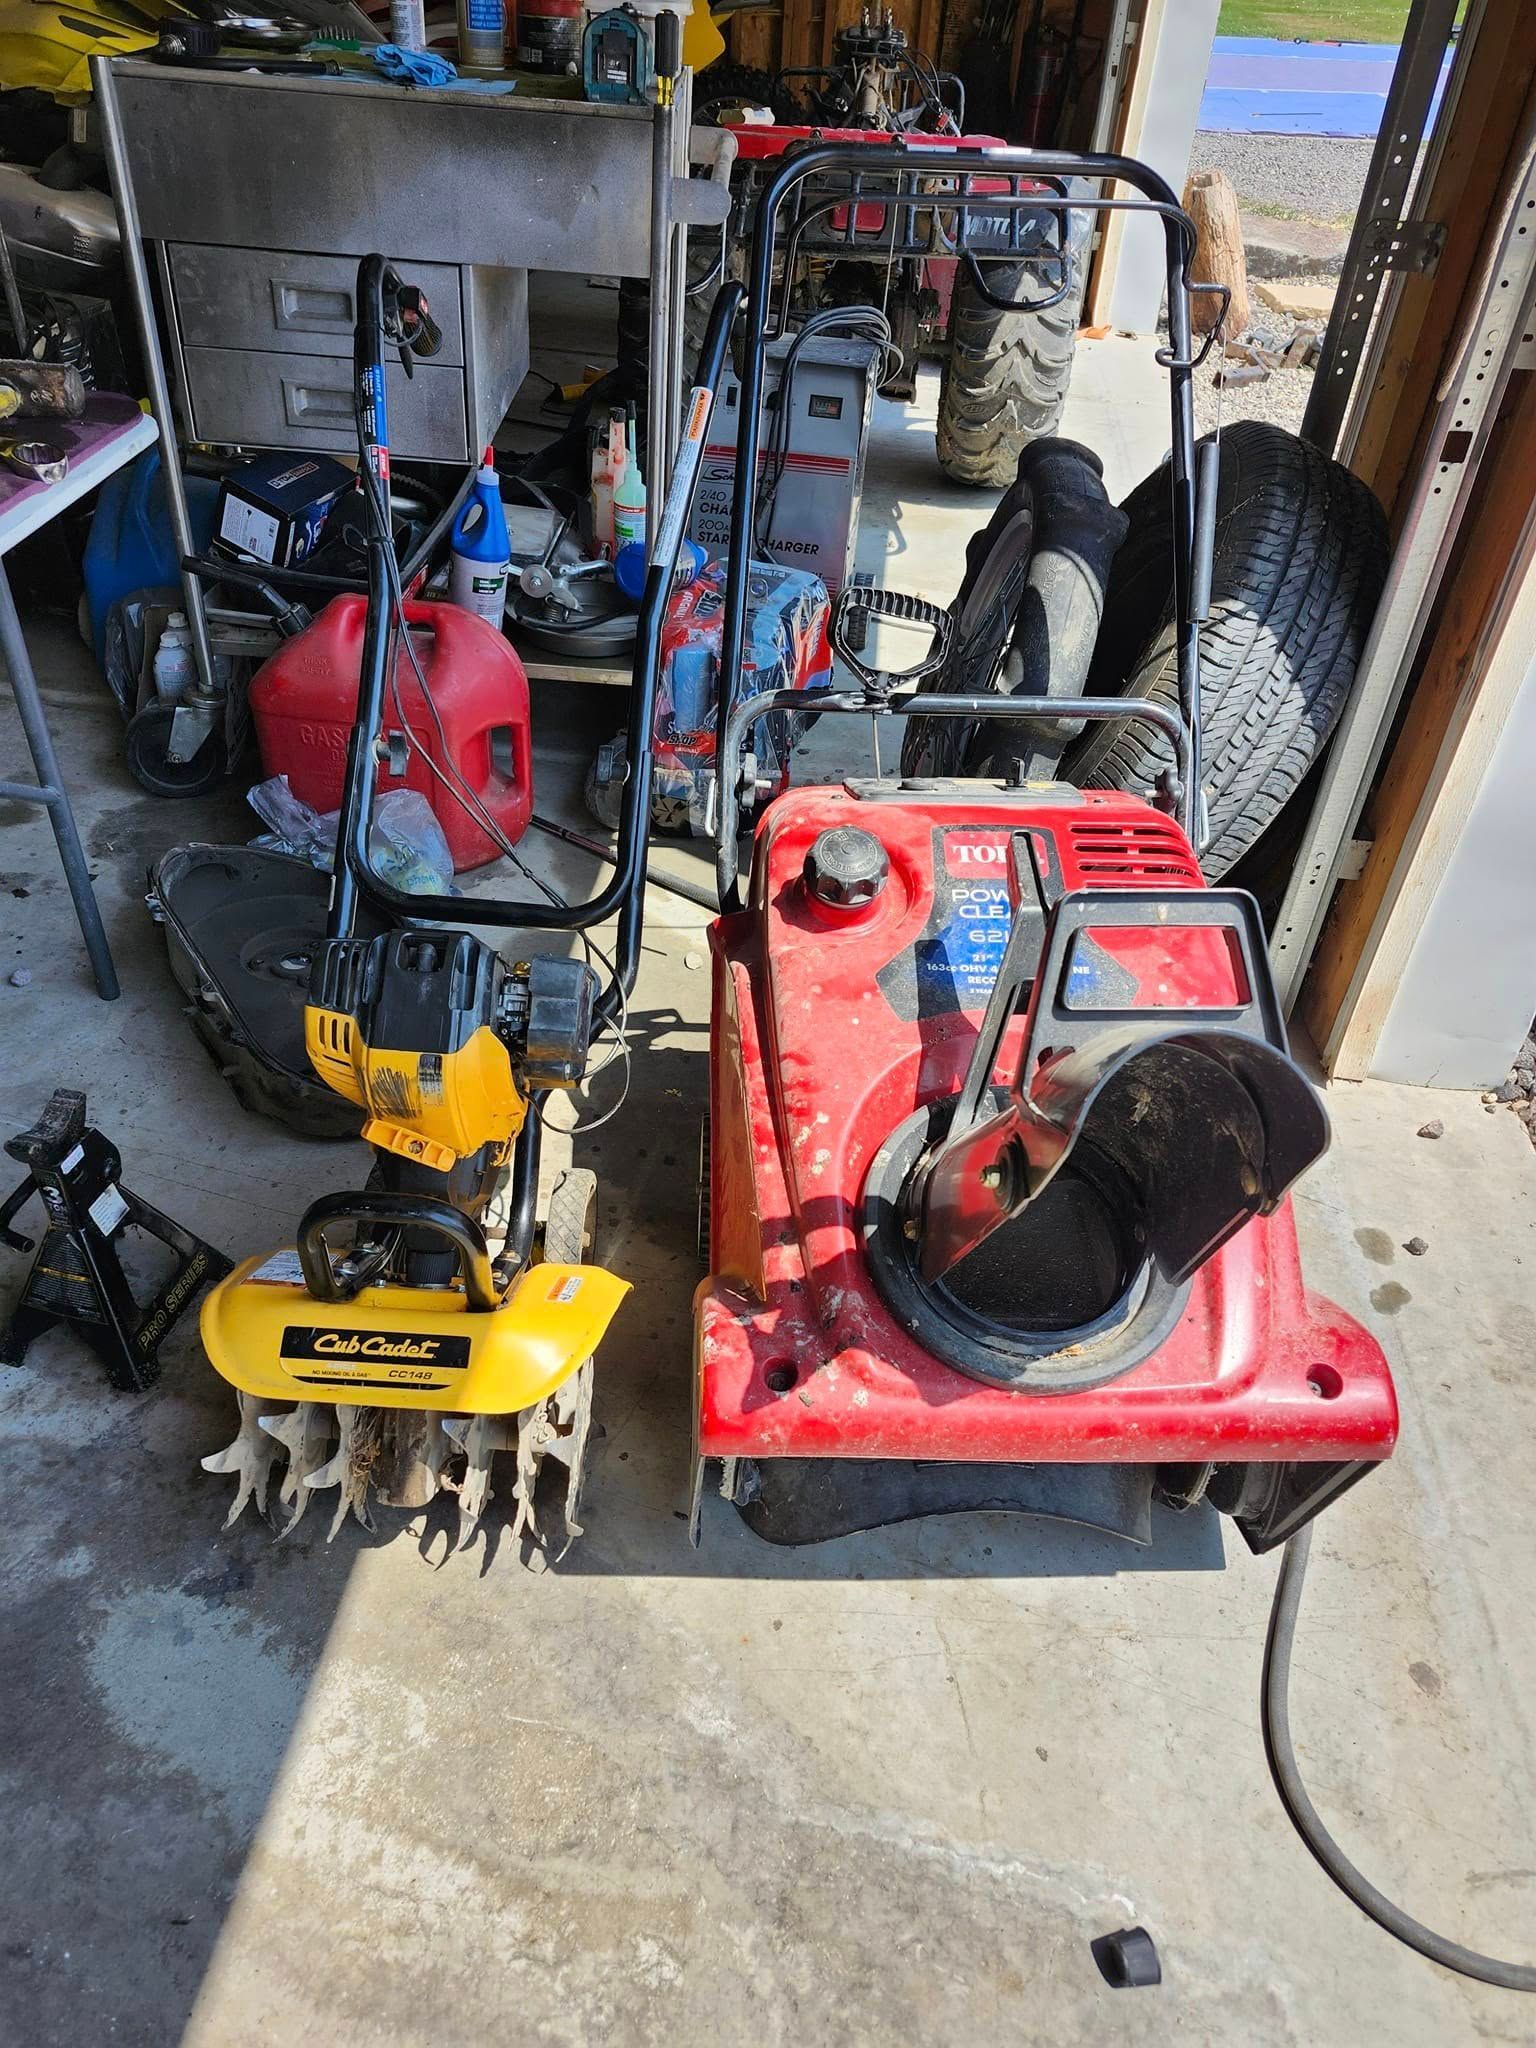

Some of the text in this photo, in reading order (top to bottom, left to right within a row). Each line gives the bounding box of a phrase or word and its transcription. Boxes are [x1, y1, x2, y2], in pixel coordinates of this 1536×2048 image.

[964, 214, 1037, 236] MOTO4
[700, 489, 726, 501] 2/40
[951, 889, 1010, 902] POW
[926, 963, 958, 972] 163cc
[960, 964, 988, 973] OHV
[138, 1252, 209, 1351] PRO SERIES
[314, 1333, 441, 1359] Cub Cadet
[388, 1369, 433, 1380] CC148
